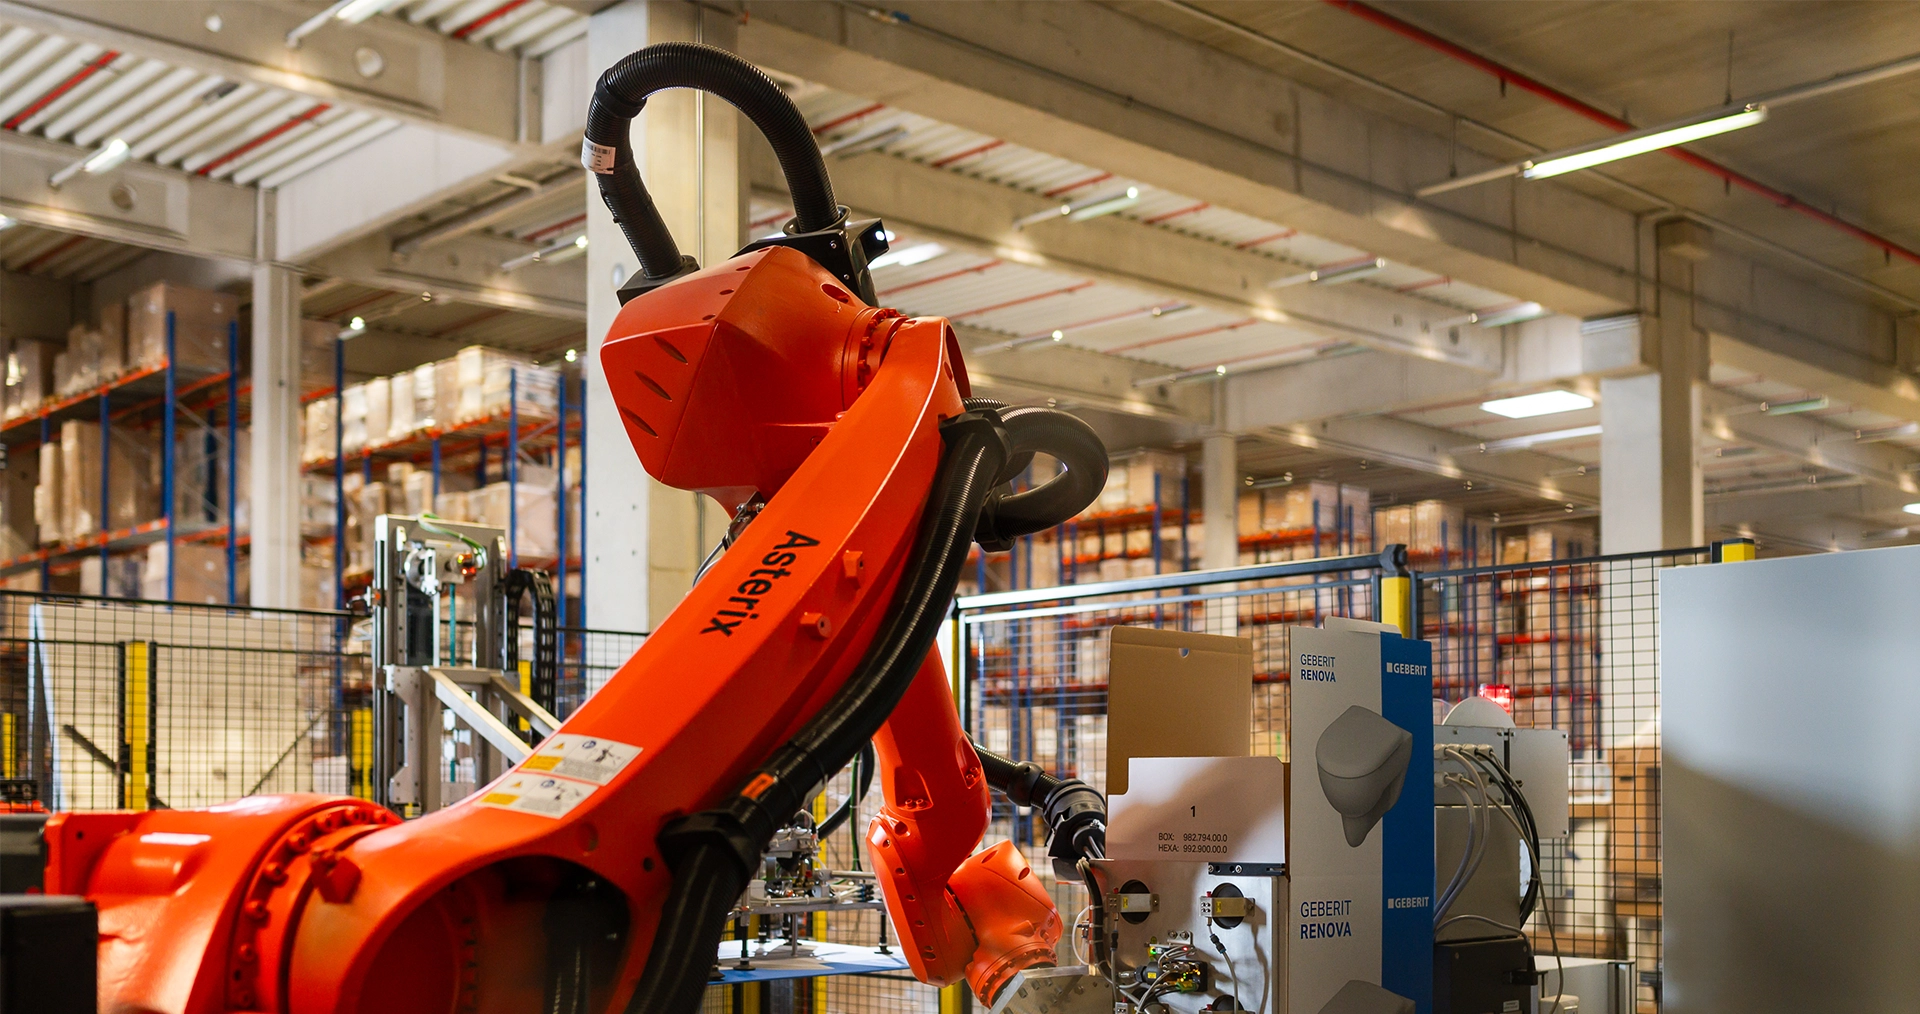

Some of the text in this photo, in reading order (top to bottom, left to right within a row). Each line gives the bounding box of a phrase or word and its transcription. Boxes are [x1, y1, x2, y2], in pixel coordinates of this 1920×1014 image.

[700, 530, 821, 637] Asterix
[1300, 653, 1336, 668] GEBERIT
[1300, 669, 1337, 683] RENOVA
[1393, 662, 1428, 676] GEBERIT
[1190, 805, 1196, 818] 1
[1158, 832, 1228, 842] BOX: 982.794.00.0
[1158, 844, 1228, 854] HEXA: 992.900.00.0
[1300, 900, 1352, 918] GEBERIT
[1394, 896, 1430, 909] GEBERIT
[1300, 921, 1352, 940] RENOVA
